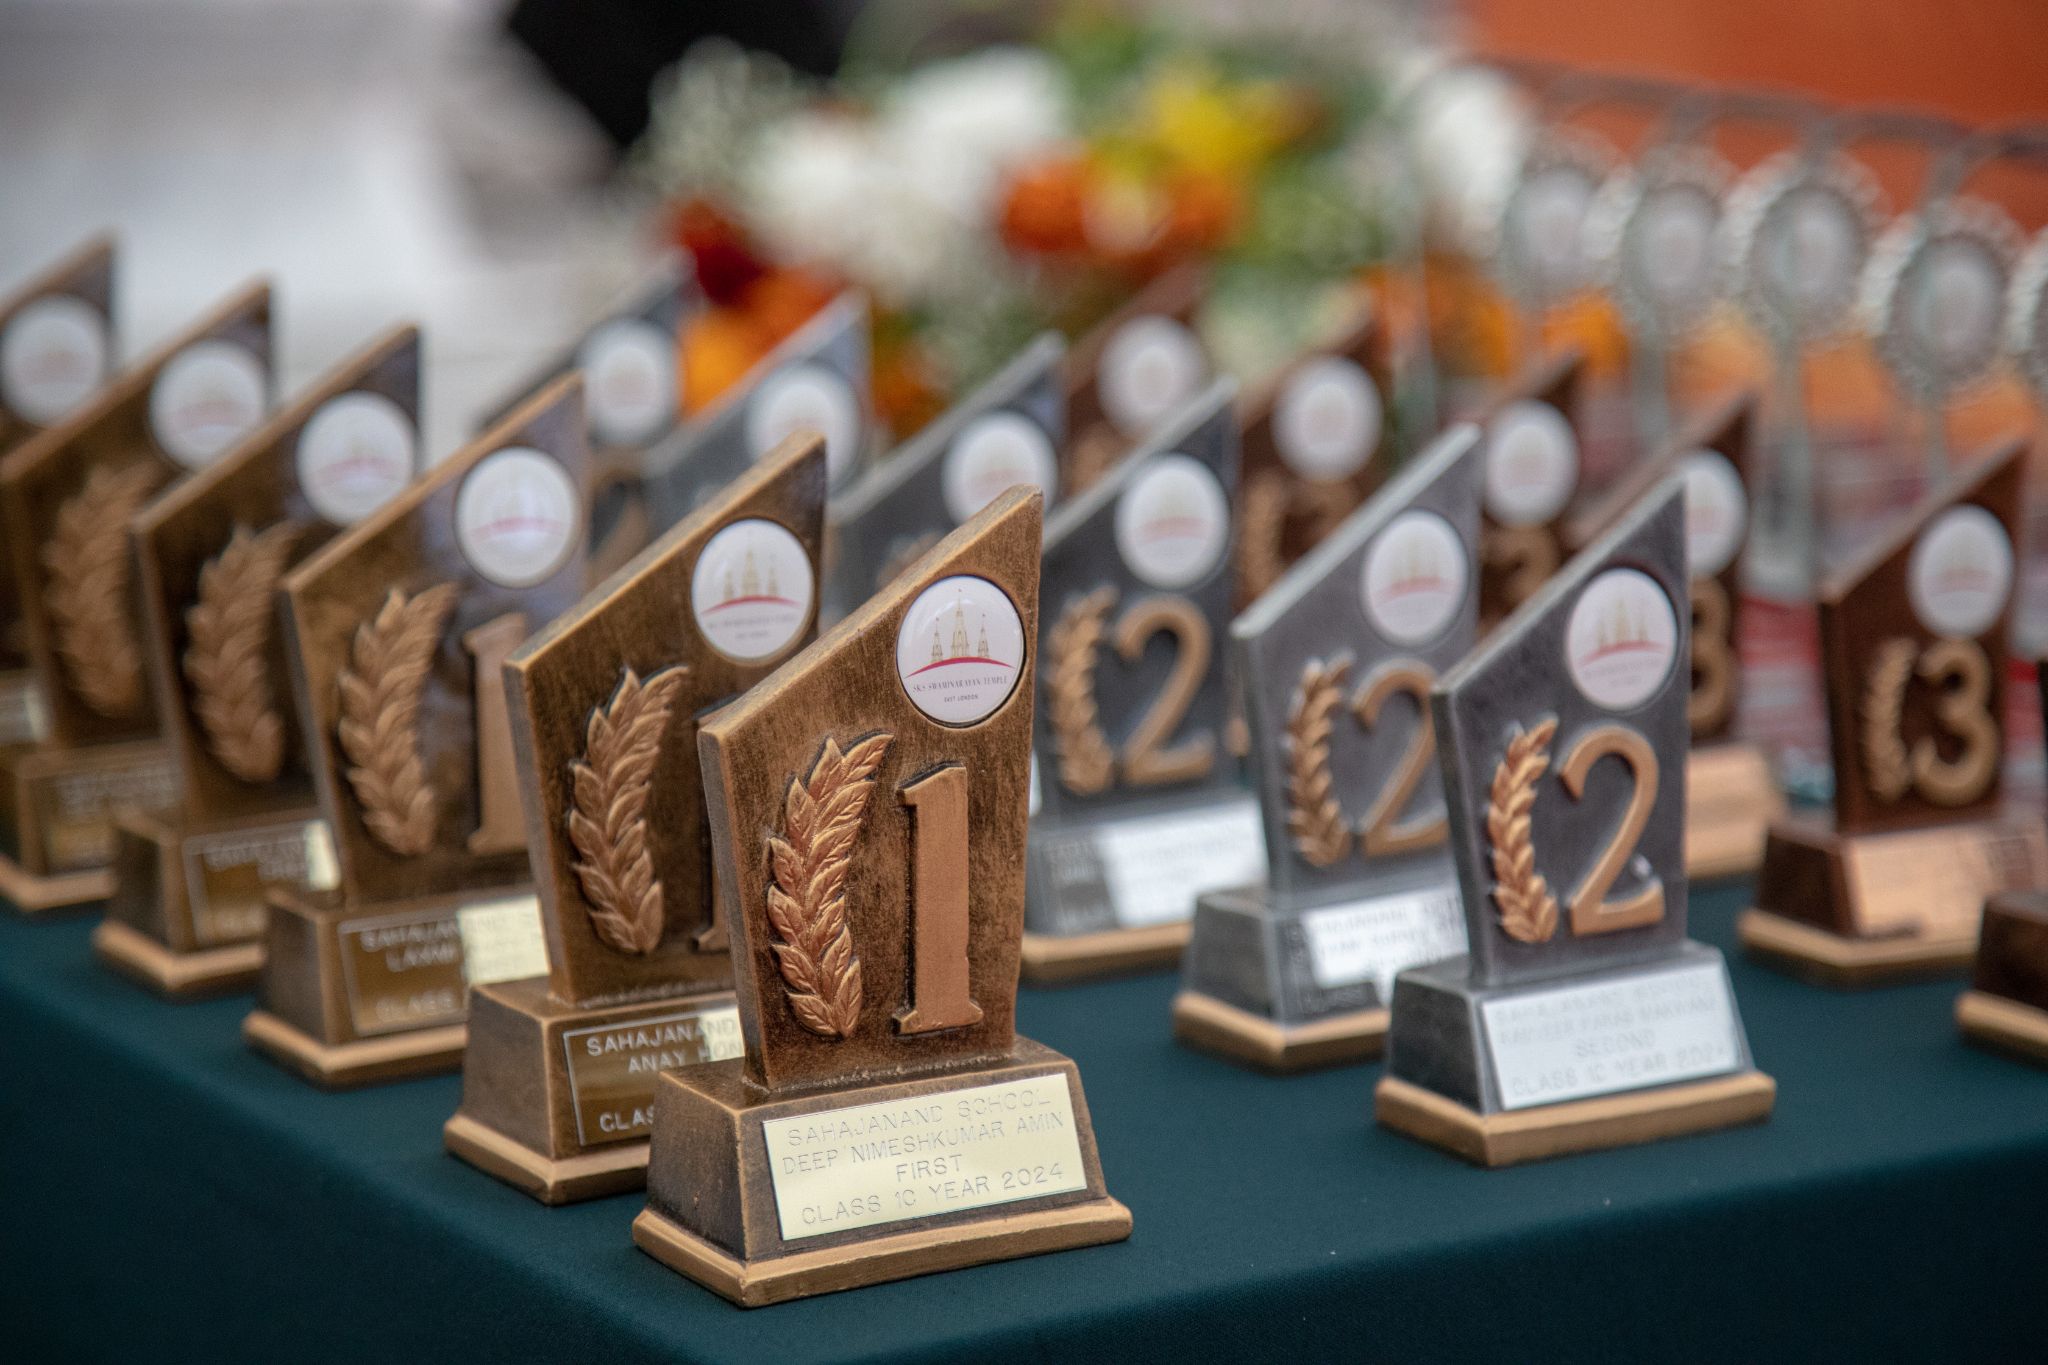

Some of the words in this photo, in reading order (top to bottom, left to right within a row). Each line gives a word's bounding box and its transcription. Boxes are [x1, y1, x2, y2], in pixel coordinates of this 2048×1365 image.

[983, 675, 1008, 686] TEMPLE
[1117, 594, 1215, 785] 2
[1911, 637, 1999, 806] 3
[1352, 658, 1450, 860] 2
[1557, 724, 1665, 937] 2
[898, 763, 984, 1036] 1
[586, 1018, 738, 1057] SAHAJANAND
[628, 1050, 688, 1073] ANAY
[1574, 1028, 1656, 1058] SECOND
[782, 1148, 838, 1176] DEEP
[850, 1120, 1005, 1164] NIMESHKUMAR
[1016, 1111, 1064, 1135] AMIN
[788, 1104, 944, 1147] SAHAJANAND
[957, 1089, 1051, 1120] SCHOOL
[801, 1194, 882, 1226] CLASS
[928, 1176, 990, 1201] YEAR
[1003, 1162, 1064, 1190] 2024
[895, 1153, 963, 1183] FIRST
